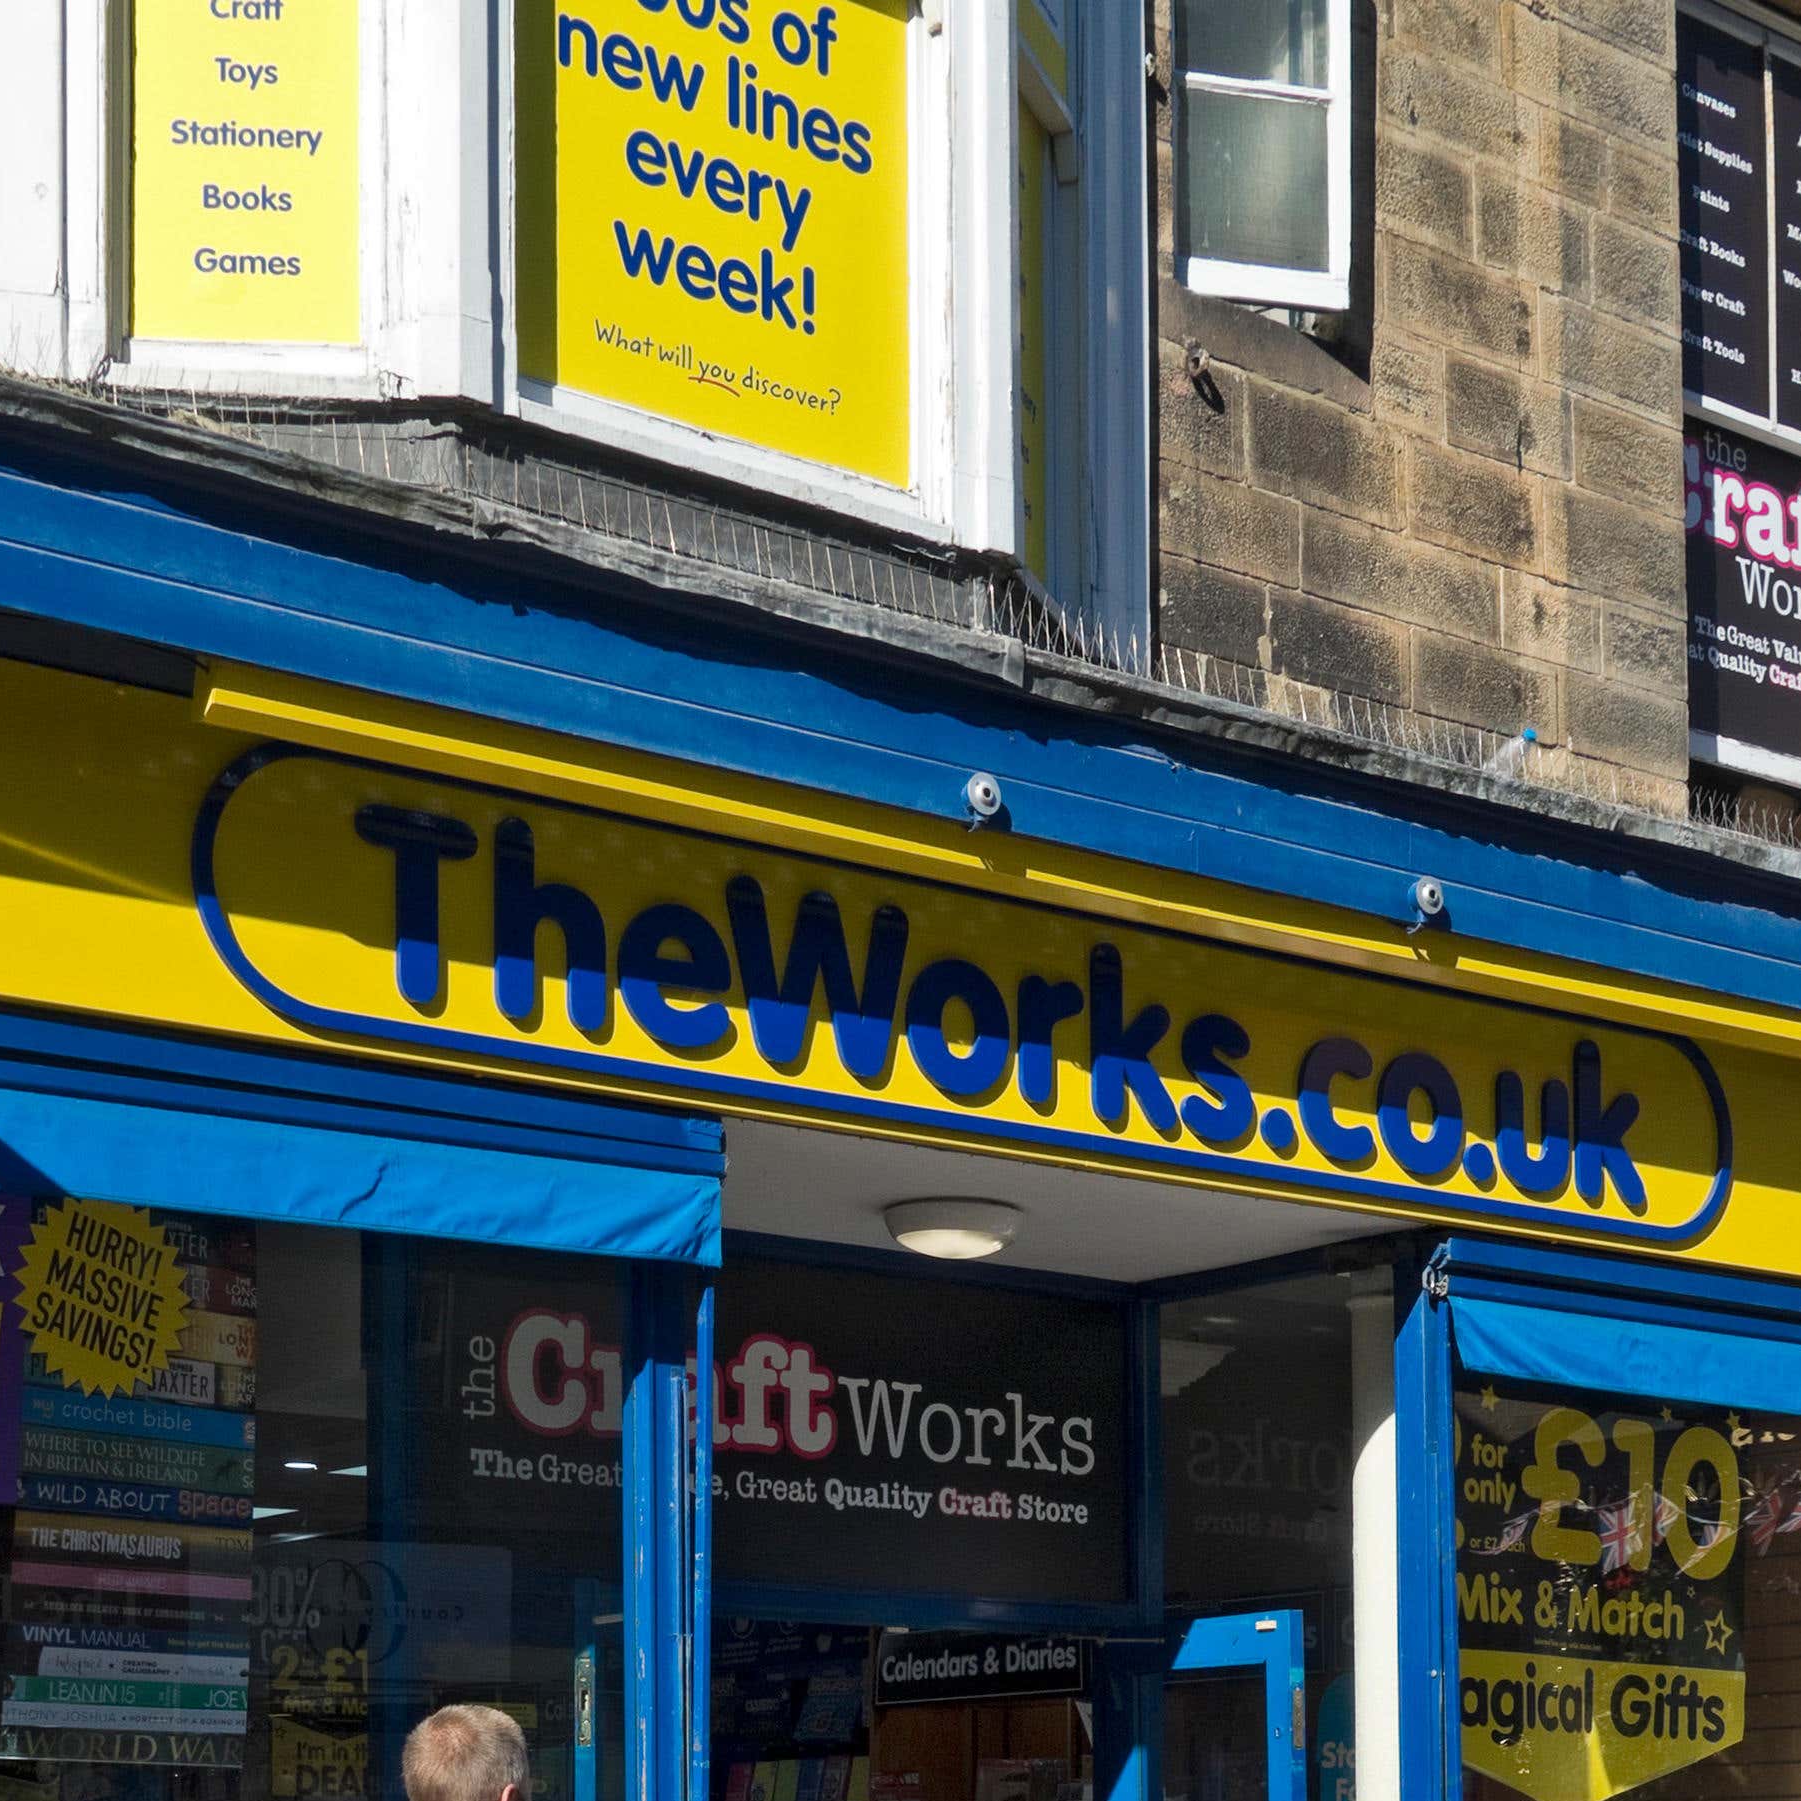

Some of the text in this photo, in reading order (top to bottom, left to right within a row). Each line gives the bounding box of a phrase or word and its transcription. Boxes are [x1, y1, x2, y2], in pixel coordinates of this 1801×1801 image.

[772, 6, 837, 76] of
[214, 57, 278, 91] Toys
[558, 13, 704, 112] new
[727, 55, 872, 174] lines
[1682, 83, 1736, 119] Canvases
[171, 119, 323, 156] Stationery
[202, 183, 293, 213] Books
[625, 130, 813, 253] every
[1693, 185, 1730, 213] Paints
[194, 247, 302, 277] Games
[613, 218, 817, 336] week!
[595, 318, 843, 414] What will you discover?
[1683, 329, 1745, 365] Craft Tools
[1704, 430, 1747, 472] the
[1708, 645, 1767, 686] Quality
[353, 802, 1649, 1218] TheWorks.co.uk
[66, 1212, 163, 1286] HURRY!
[46, 1249, 165, 1331] MASSIVE
[32, 1292, 156, 1374] SAVINGS!
[462, 1334, 496, 1422] the
[836, 1375, 1097, 1478] Works
[24, 1431, 206, 1467] WHERE TO SEE WILDLIFE
[24, 1451, 199, 1483] IN BRITAIN & IRELAND
[470, 1447, 625, 1489] The Great
[1471, 1432, 1507, 1470] for
[38, 1484, 251, 1519] WILD ABOUT space
[735, 1469, 1089, 1526] Great Quality Craft Store
[1464, 1471, 1517, 1514] only
[1521, 1407, 1743, 1581] £10
[31, 1527, 57, 1548] THE
[61, 1528, 182, 1560] CHRISTMASAURUS
[22, 1626, 77, 1645] VINYL
[80, 1629, 152, 1649] MANUAL
[882, 1638, 1077, 1684] Calendars & Diaries
[1459, 1659, 1727, 1746] agical Gifts
